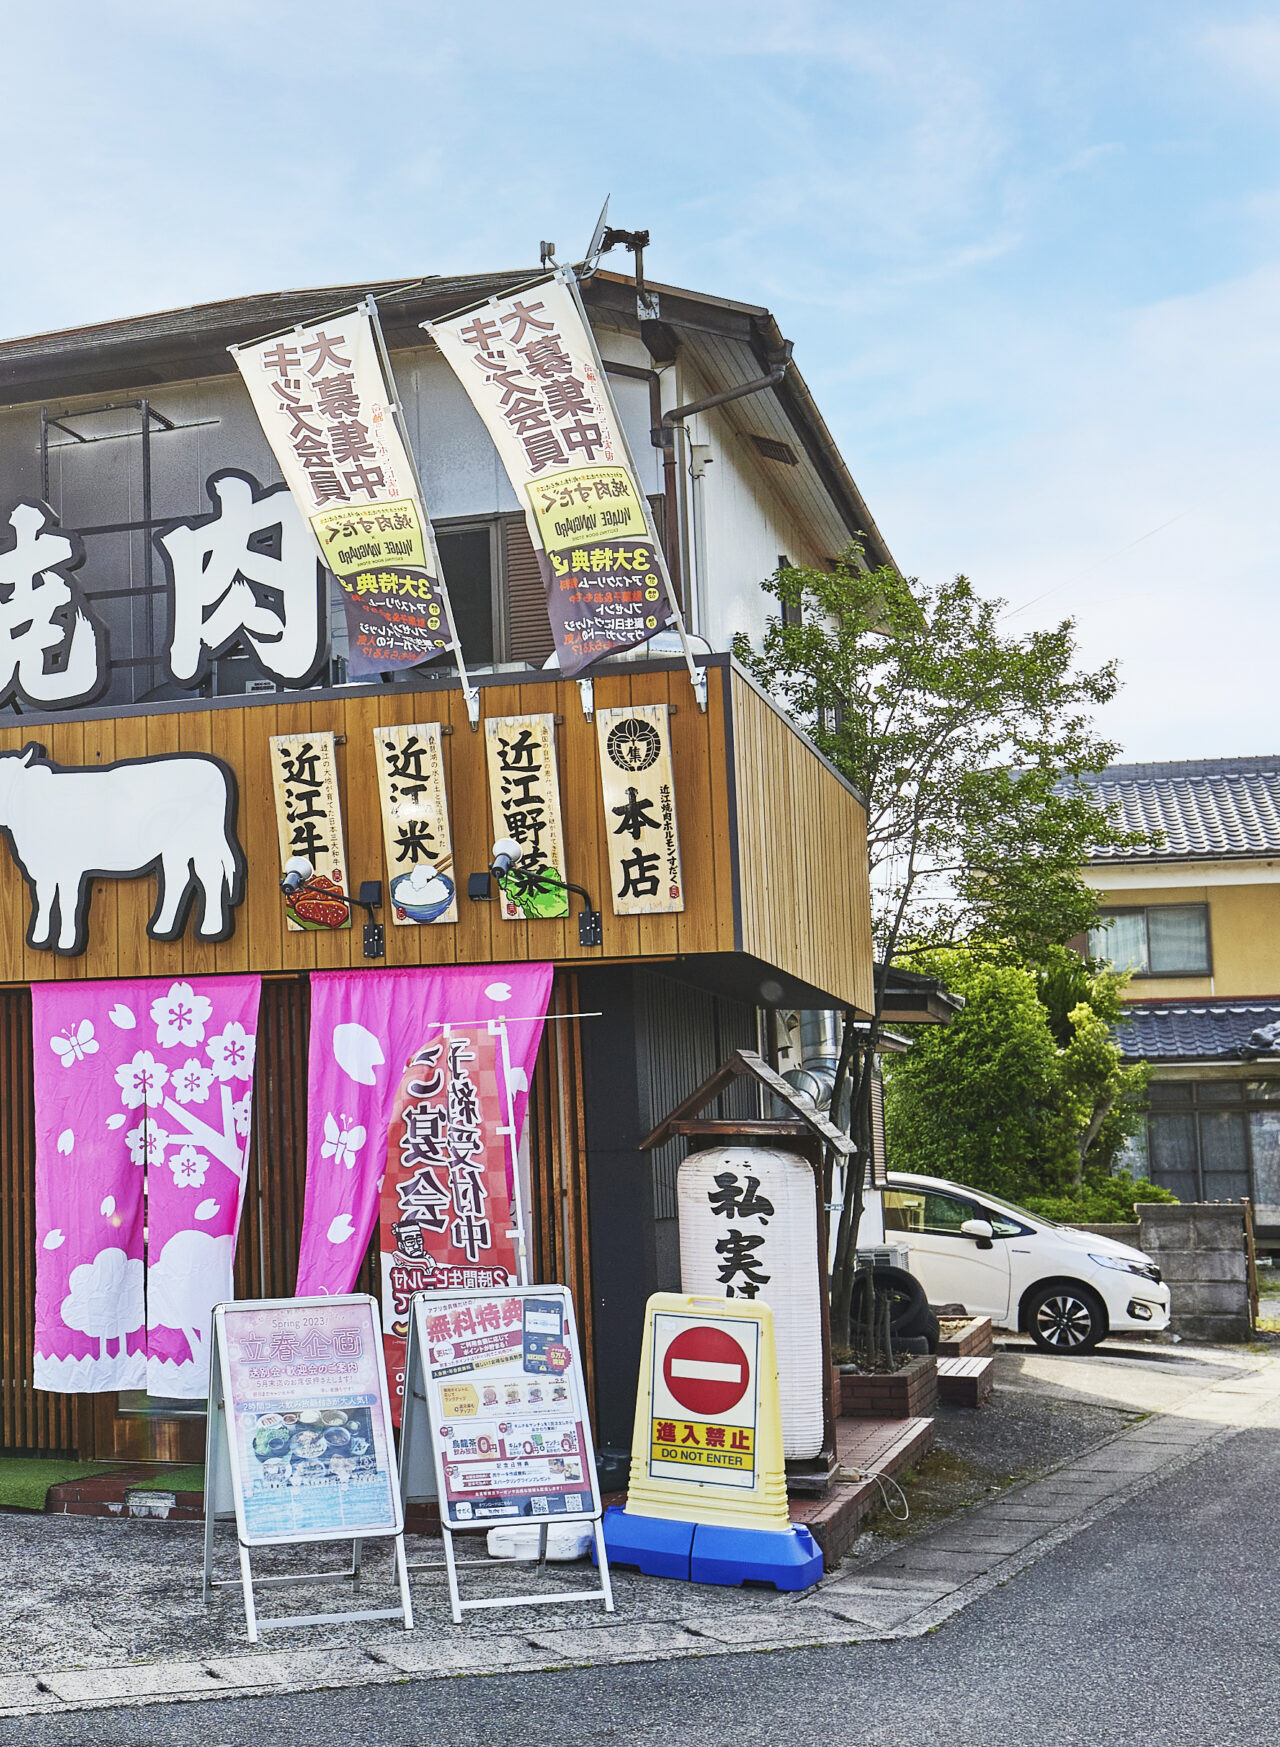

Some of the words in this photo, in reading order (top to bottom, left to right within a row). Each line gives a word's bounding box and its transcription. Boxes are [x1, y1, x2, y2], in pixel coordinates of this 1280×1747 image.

[280, 742, 330, 868] 近江牛
[384, 736, 440, 863] 近江米
[497, 729, 552, 897] 近江野菜
[659, 784, 678, 884] 近江焼肉ホルモンすだく
[612, 786, 662, 898] 本店
[239, 1327, 363, 1364] 立春企画
[272, 1318, 300, 1329] Spring
[426, 1298, 522, 1343] 無料特典
[656, 1421, 750, 1451] 進入禁止
[661, 1447, 679, 1460] DO
[681, 1449, 705, 1462] NOT
[707, 1452, 743, 1466] ENTER
